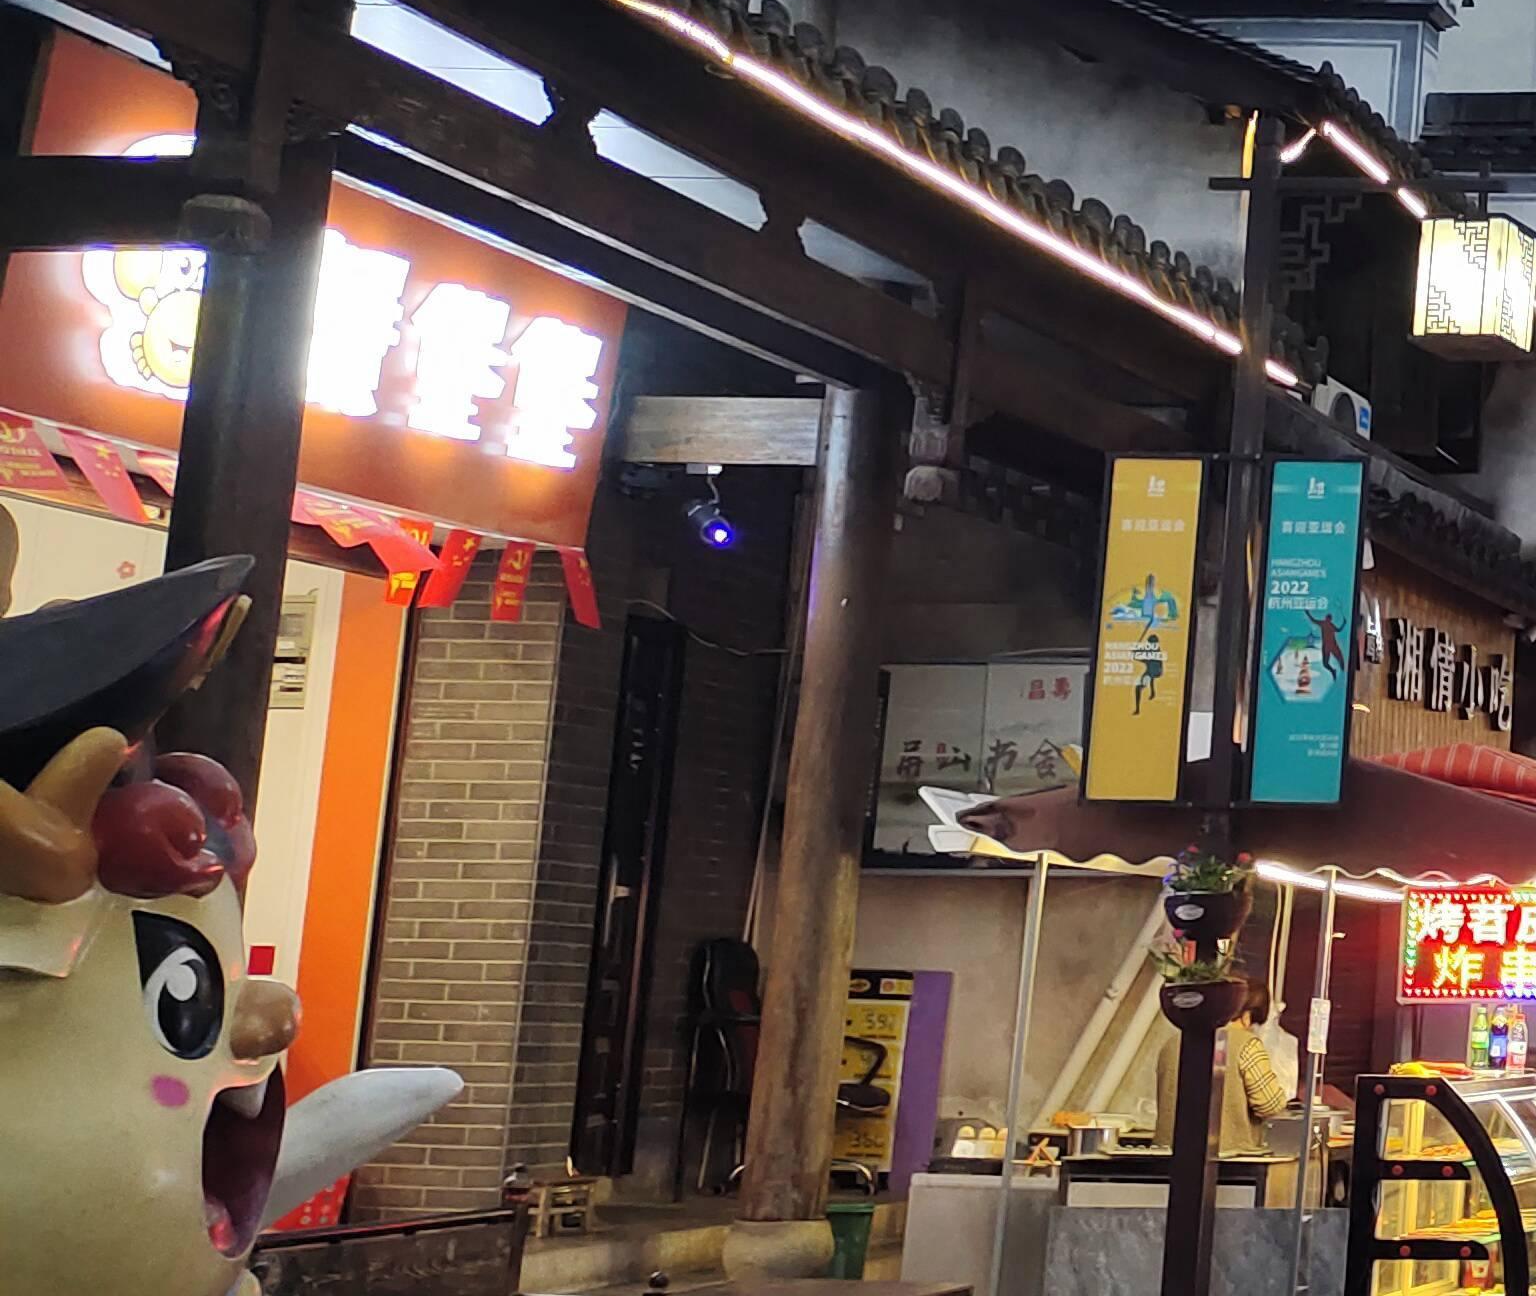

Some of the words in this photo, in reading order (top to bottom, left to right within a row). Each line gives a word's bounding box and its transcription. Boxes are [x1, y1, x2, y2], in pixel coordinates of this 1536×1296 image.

[1271, 581, 1309, 594] 2022
[1392, 618, 1512, 731] 湘情小吃
